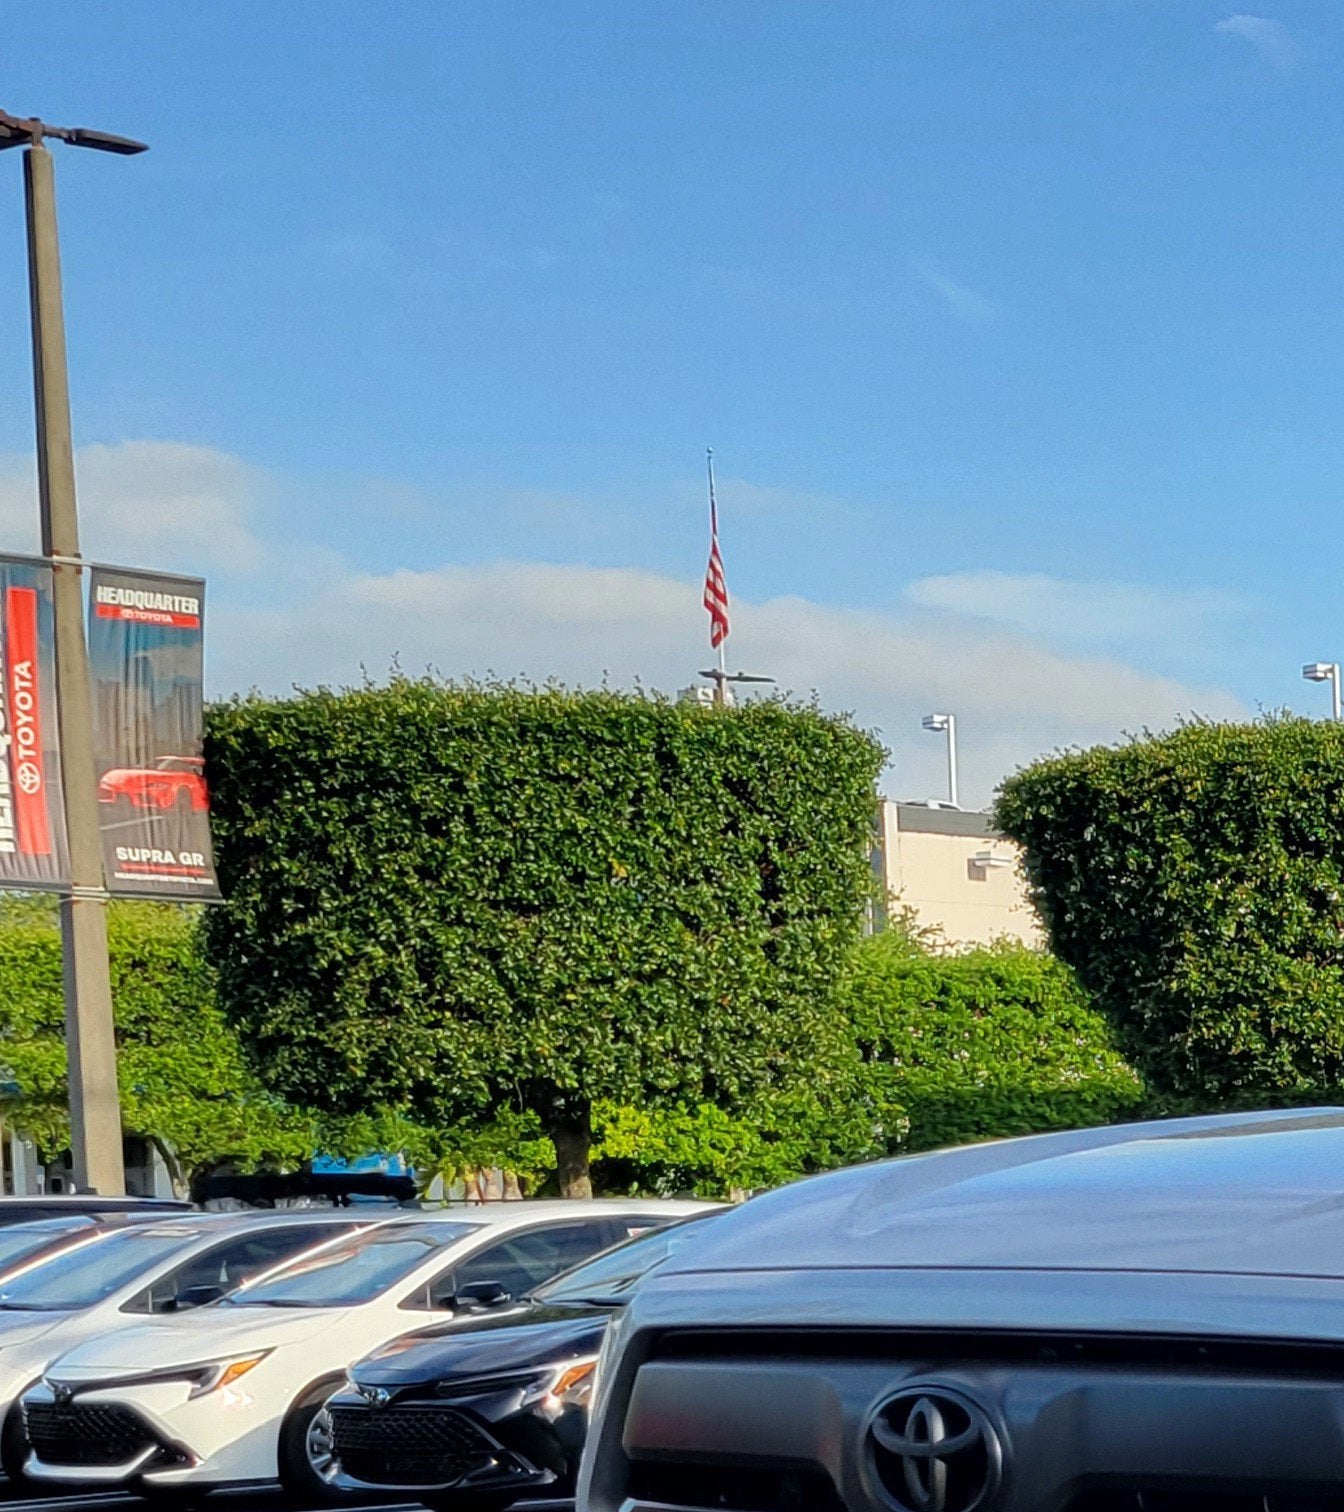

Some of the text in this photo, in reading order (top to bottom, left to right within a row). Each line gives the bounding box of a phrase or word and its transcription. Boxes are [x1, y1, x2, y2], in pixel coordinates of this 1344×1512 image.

[97, 585, 199, 615] HEADQUARTER
[134, 610, 174, 624] TOYOTA
[14, 660, 37, 762] TOYOTA
[115, 847, 206, 867] SUPRA GR
